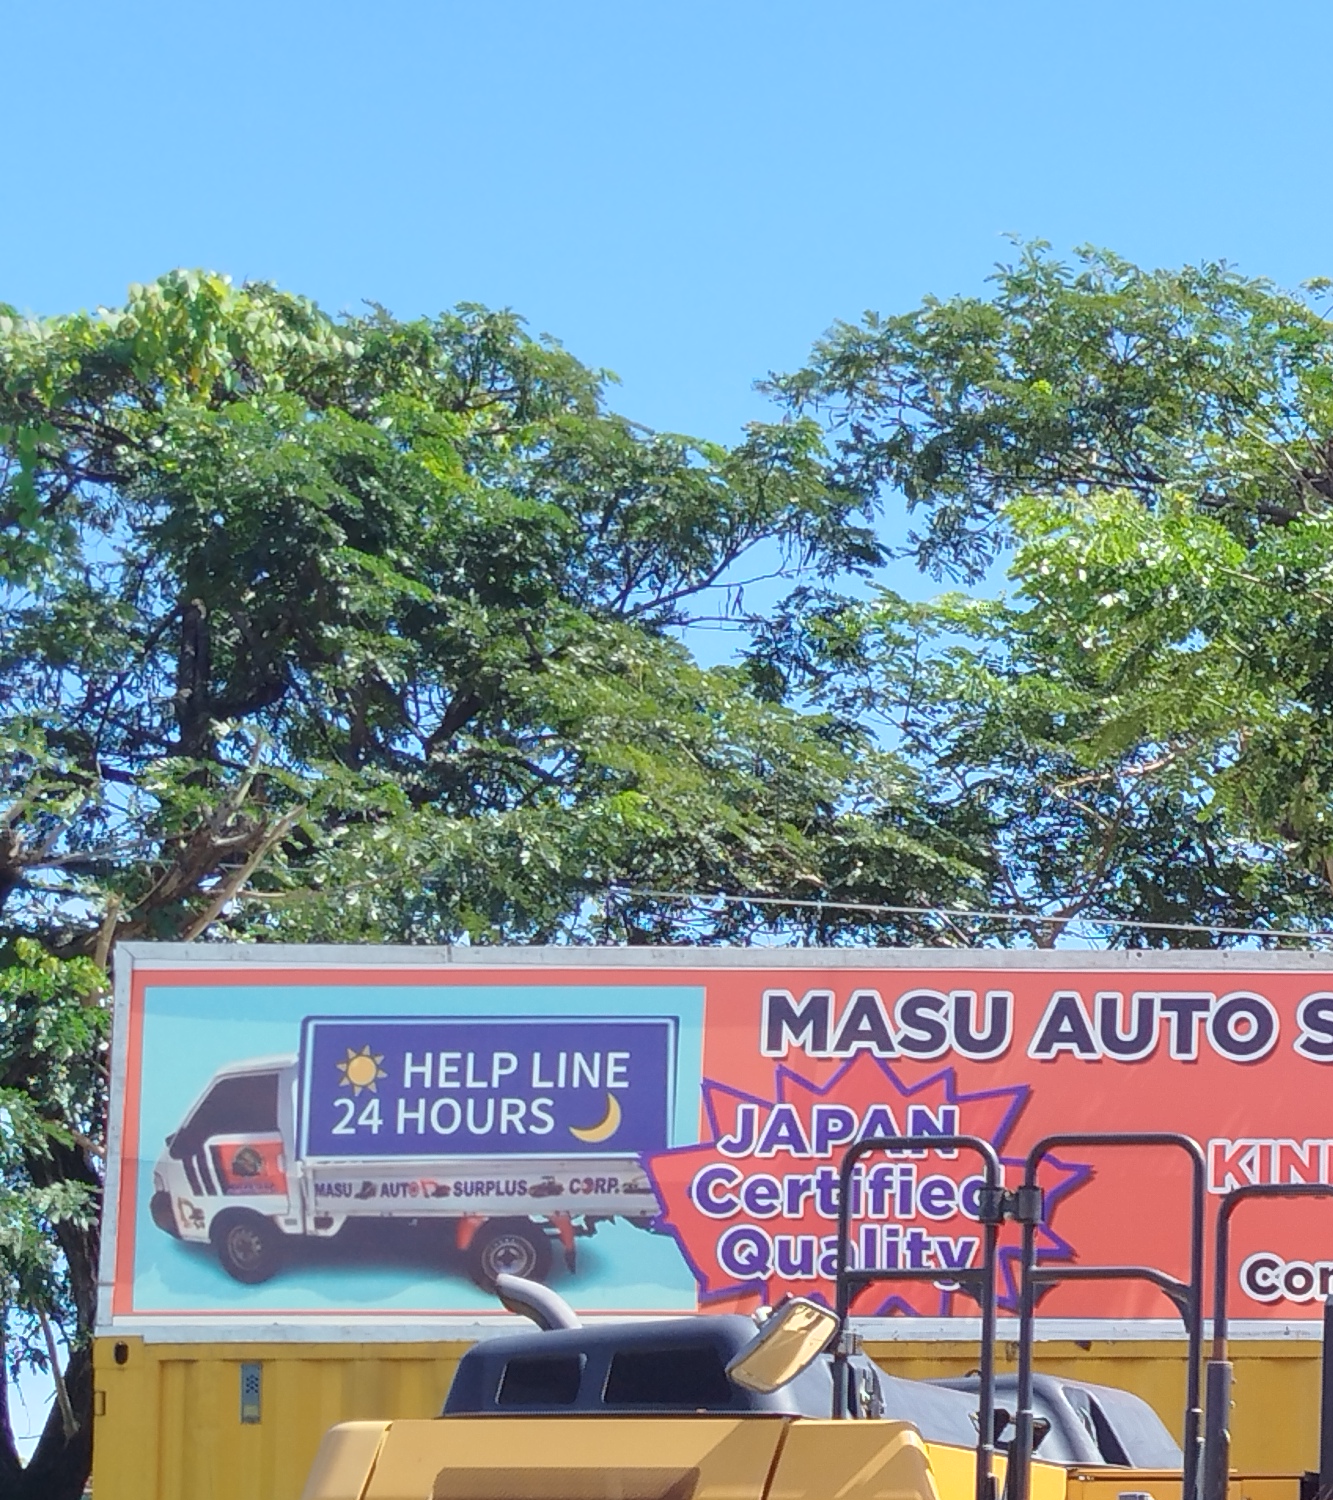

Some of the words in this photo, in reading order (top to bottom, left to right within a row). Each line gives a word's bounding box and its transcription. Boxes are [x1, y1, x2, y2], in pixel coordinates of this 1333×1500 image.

[760, 988, 1014, 1059] MASU
[1028, 990, 1281, 1062] AUTO
[402, 1051, 518, 1089] HELP
[531, 1051, 631, 1089] LINE
[330, 1097, 384, 1135] 24
[396, 1097, 556, 1136] HOURS
[717, 1104, 960, 1159] JAPAN
[314, 1182, 353, 1198] MASU
[452, 1179, 528, 1198] SURPLUS
[716, 1223, 980, 1291] Quality
